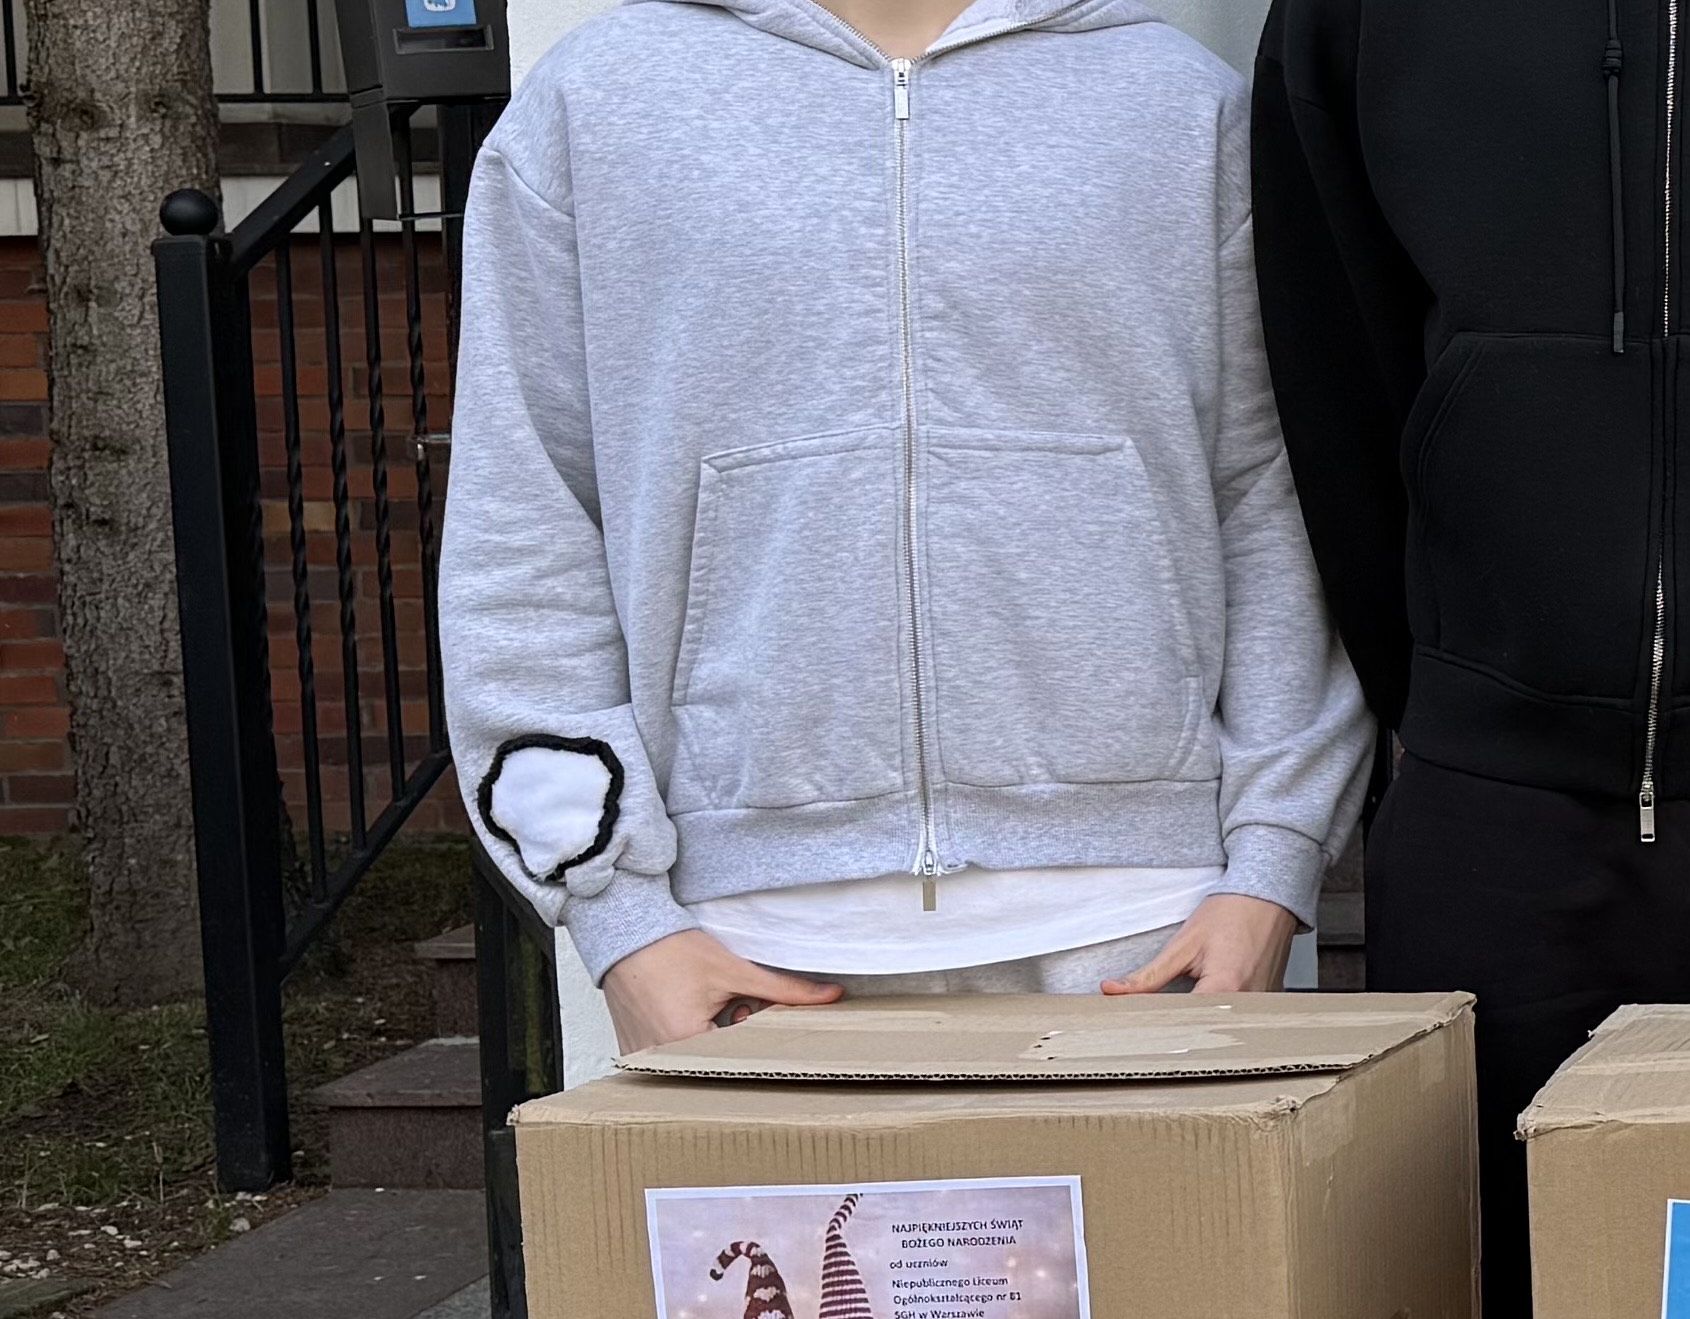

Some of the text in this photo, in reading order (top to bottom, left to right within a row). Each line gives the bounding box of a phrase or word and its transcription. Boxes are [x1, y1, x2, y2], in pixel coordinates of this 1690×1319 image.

[891, 1218, 1024, 1234] NAJPIĘKNIEJSZYCH ŚWIĄT
[901, 1235, 1017, 1249] BOŻEGO NARODZENIA
[889, 1259, 949, 1270] od uczniów
[892, 1276, 1009, 1290] Niepublicznego Liceum
[893, 1292, 993, 1306] Ogólnokształcącego
[996, 1294, 1007, 1302] nr
[918, 1311, 928, 1319] w
[930, 1309, 985, 1319] Warszawie
